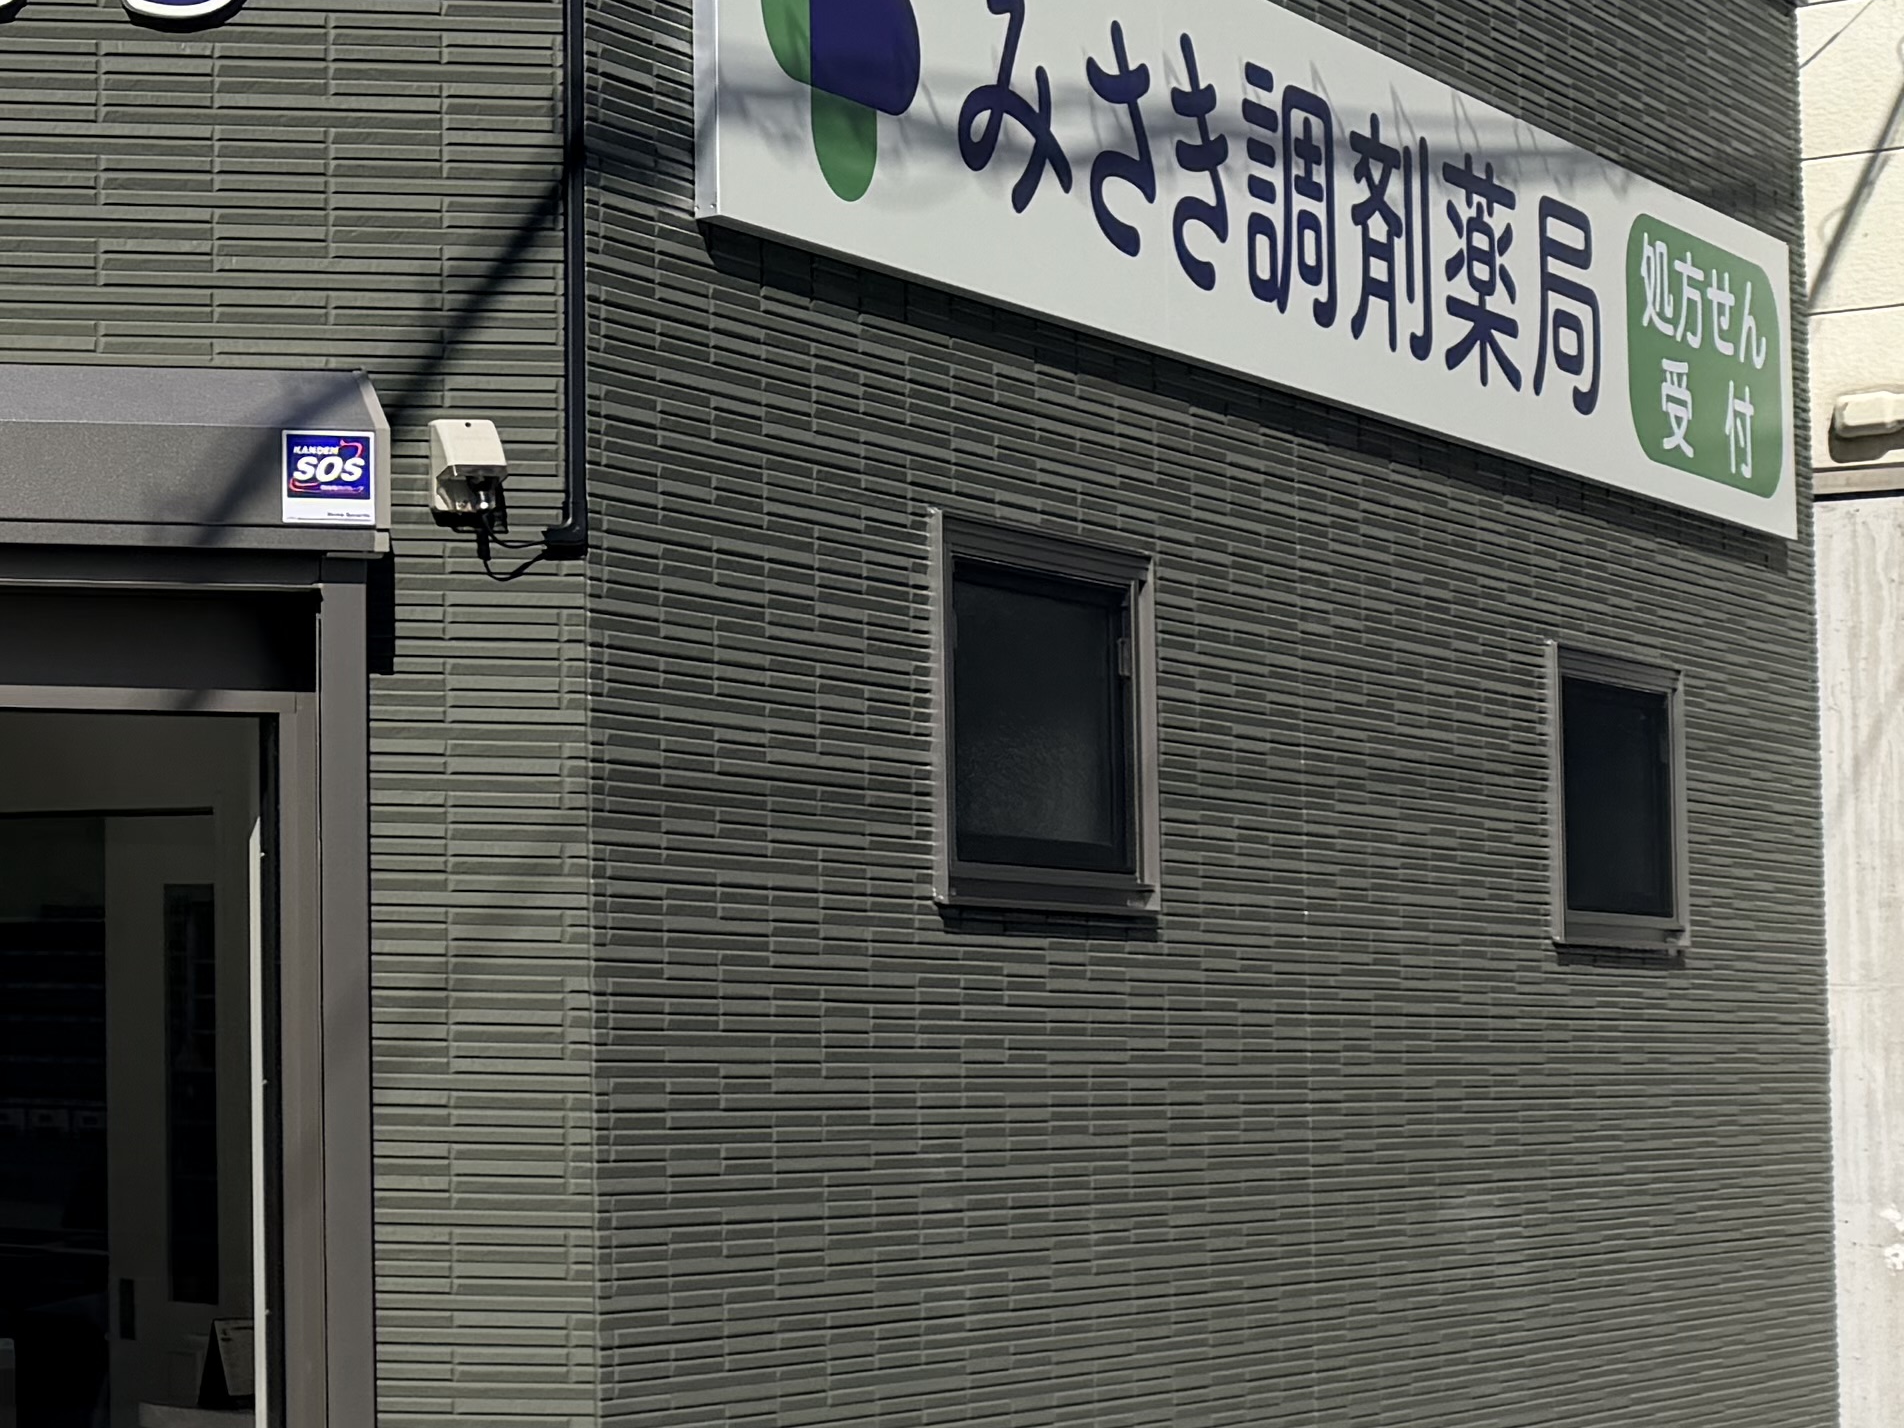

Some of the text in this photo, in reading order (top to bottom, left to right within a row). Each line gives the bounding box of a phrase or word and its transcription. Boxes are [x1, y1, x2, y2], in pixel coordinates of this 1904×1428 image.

[1641, 231, 1767, 370] 処方せん
[293, 456, 366, 482] SOS
